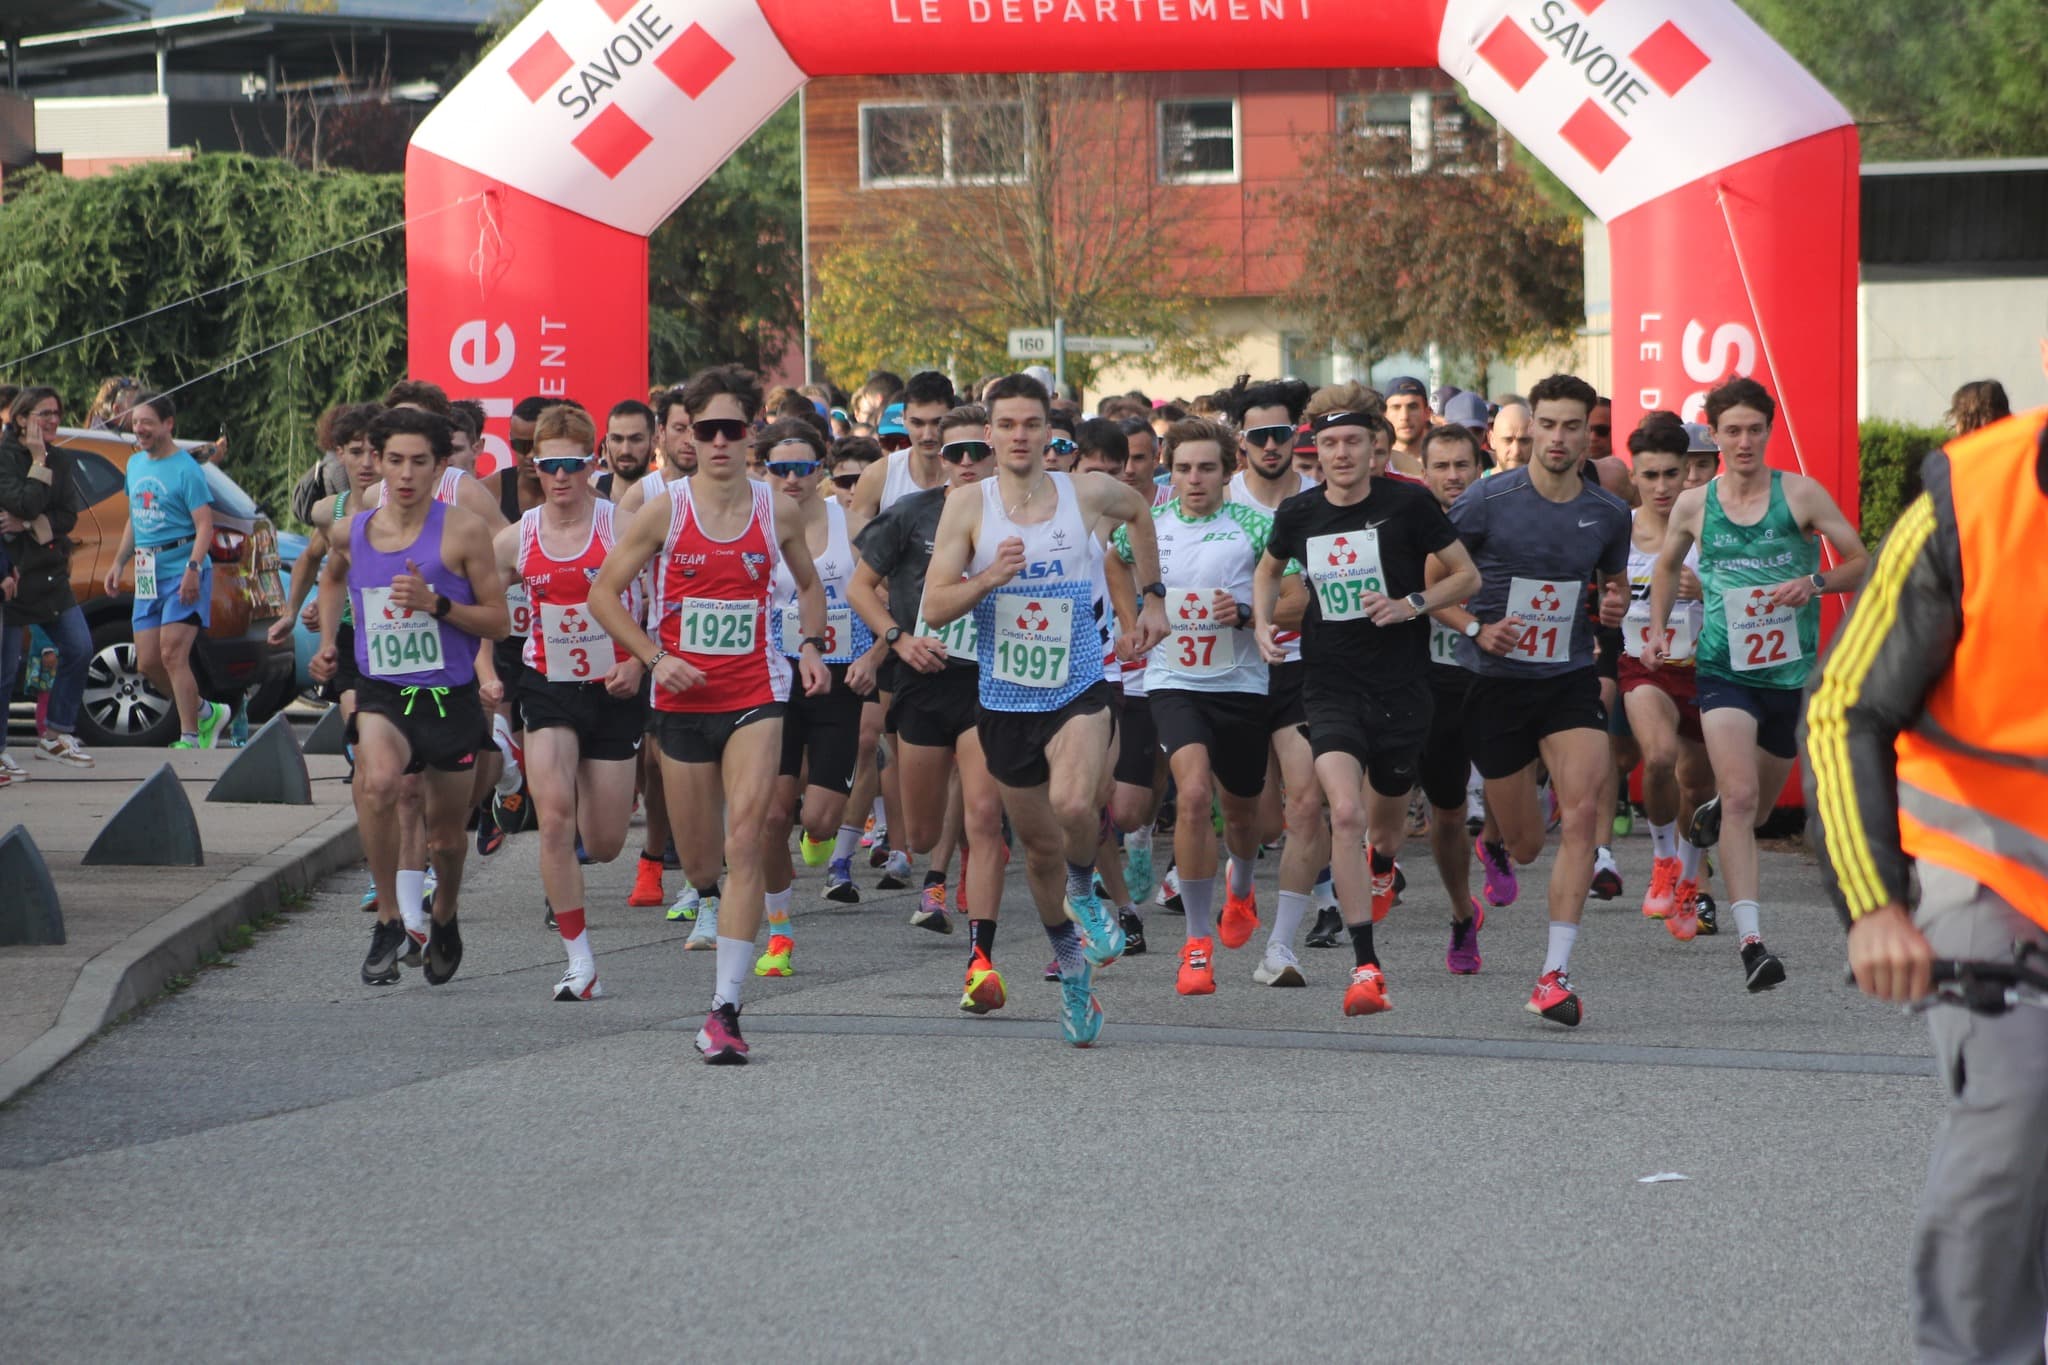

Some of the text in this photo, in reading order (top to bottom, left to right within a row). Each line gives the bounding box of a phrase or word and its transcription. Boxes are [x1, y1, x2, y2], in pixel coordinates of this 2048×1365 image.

[889, 0, 941, 23] LE
[558, 4, 673, 119] SAVOIE
[1530, 1, 1648, 117] SAVOIE
[539, 315, 567, 395] ENT
[1018, 338, 1044, 351] 160
[1640, 313, 1662, 410] LE D
[674, 553, 706, 565] TEAM
[1348, 566, 1377, 576] Mutuel
[525, 573, 551, 586] TEAM
[690, 600, 715, 610] Crédit
[725, 603, 751, 611] Mutuel
[685, 612, 753, 648] 1925
[1034, 634, 1062, 642] Mutuel
[1517, 625, 1557, 657] 41
[371, 631, 438, 668] 1940
[569, 648, 590, 677] 3
[998, 640, 1066, 681] 1997
[1177, 636, 1216, 667] 37
[1744, 629, 1787, 665] 22
